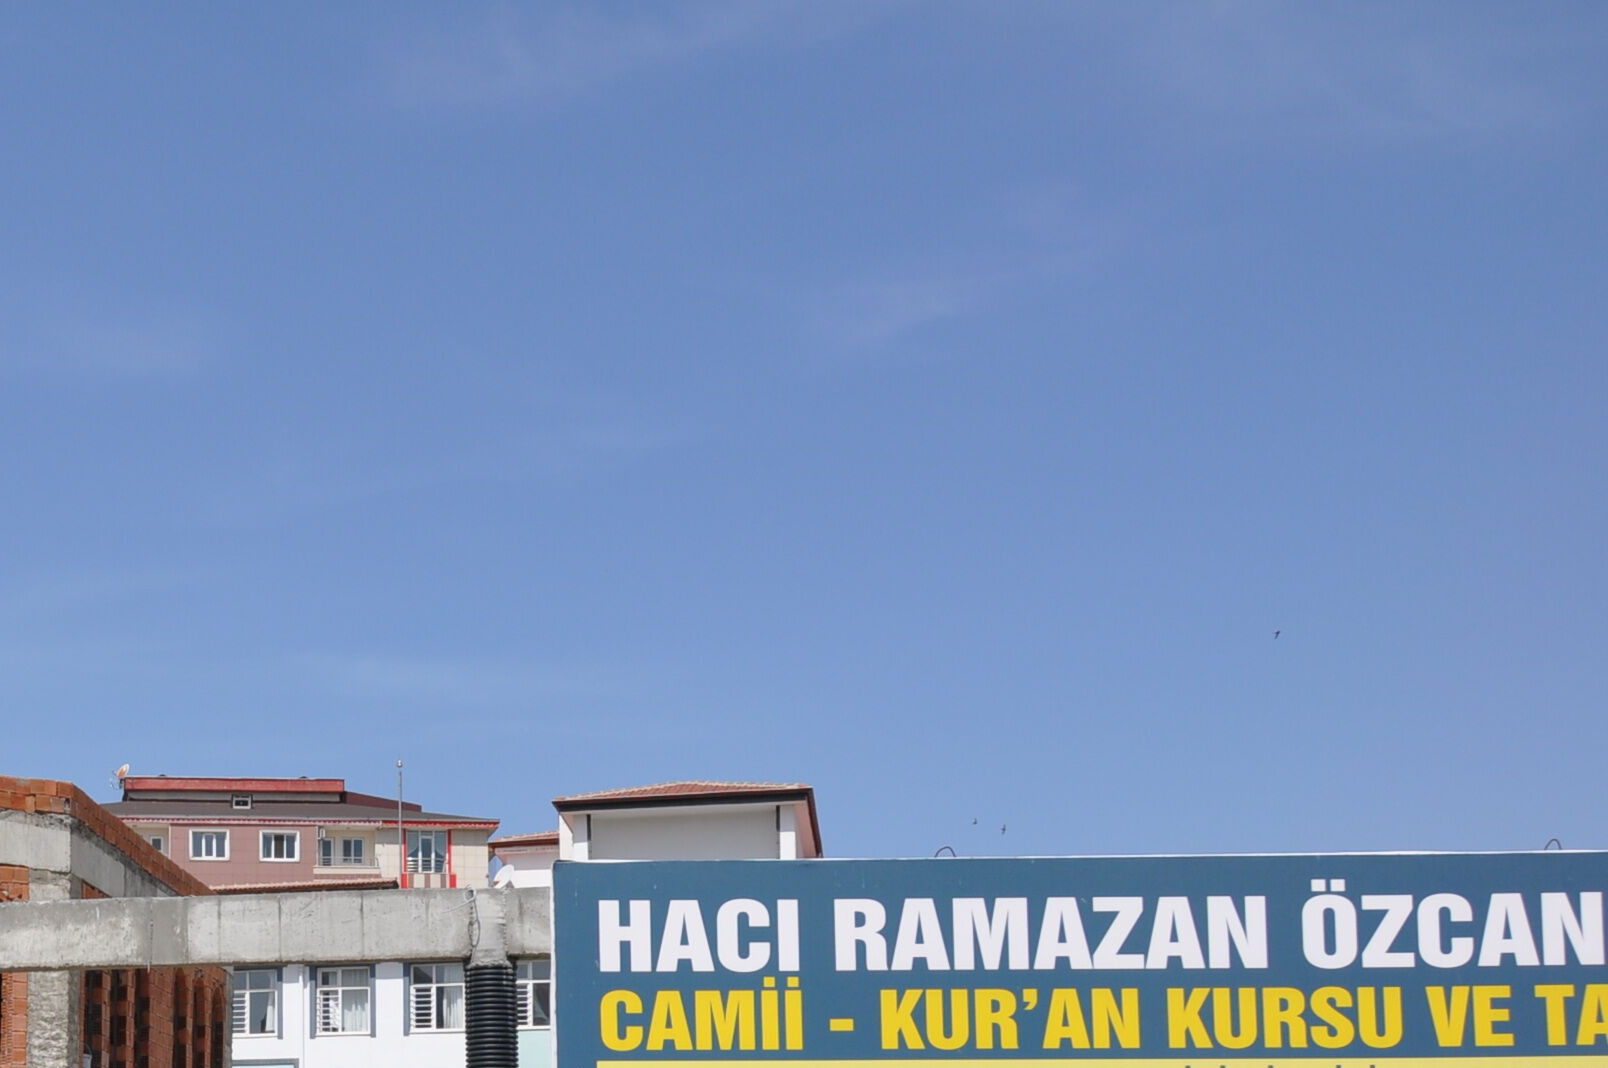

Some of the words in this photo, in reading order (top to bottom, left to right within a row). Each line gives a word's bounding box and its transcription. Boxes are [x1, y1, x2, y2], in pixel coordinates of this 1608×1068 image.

[598, 898, 800, 973] HACI
[833, 895, 1269, 972] RAMAZAN
[1301, 878, 1606, 970] ÖZCAN
[599, 976, 804, 1052] CAMİİ
[829, 1018, 854, 1032] -
[1166, 986, 1403, 1049] KURSU
[1425, 984, 1515, 1047] VE
